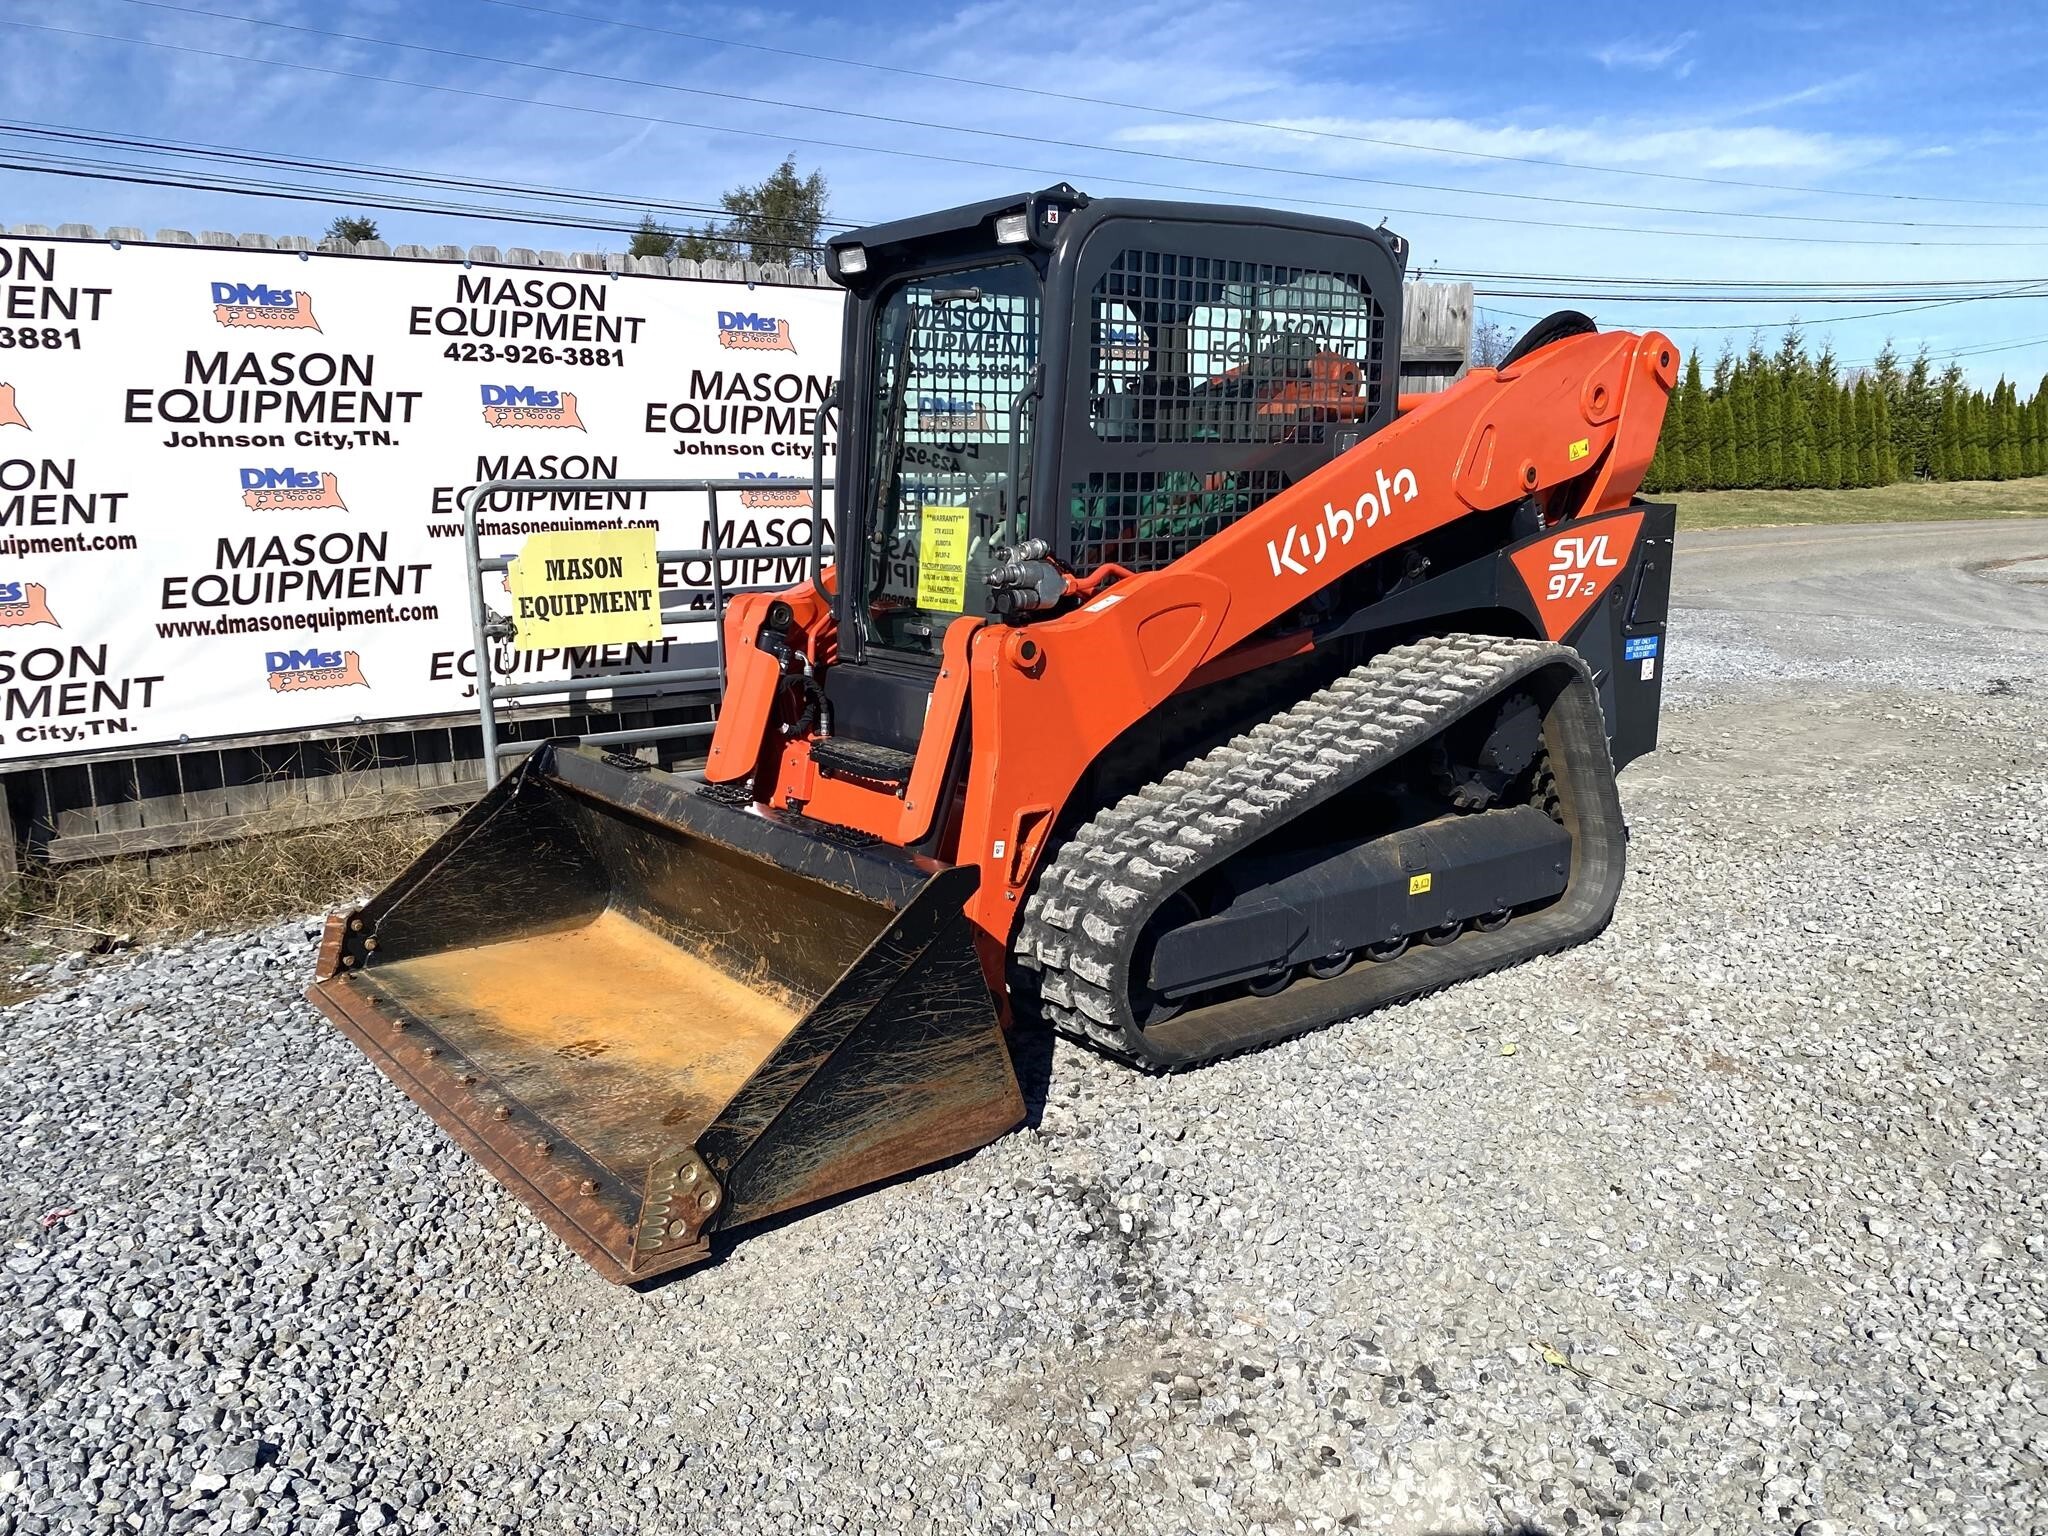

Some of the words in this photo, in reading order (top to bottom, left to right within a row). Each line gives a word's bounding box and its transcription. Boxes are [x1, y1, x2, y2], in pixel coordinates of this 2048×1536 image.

[456, 275, 607, 311] MASON
[409, 306, 646, 344] EQUIPMENT
[184, 350, 374, 387] MASON
[443, 342, 625, 367] 423-926-3881
[690, 370, 833, 404] MASON
[125, 388, 423, 424] EQUIPMENT
[163, 431, 285, 448] Johnson
[294, 430, 399, 450] City,TN.
[673, 441, 765, 456] Johnson
[475, 455, 618, 481] MASON
[1266, 468, 1419, 577] Kubota
[215, 531, 388, 569] MASON
[1548, 535, 1618, 571] SVL
[161, 563, 433, 609] EQUIPMENT
[545, 556, 623, 582] MASON
[1546, 572, 1596, 600] 97-2
[156, 603, 440, 639] www.dmasonequipment.com
[519, 590, 653, 620] EQUIPMENT
